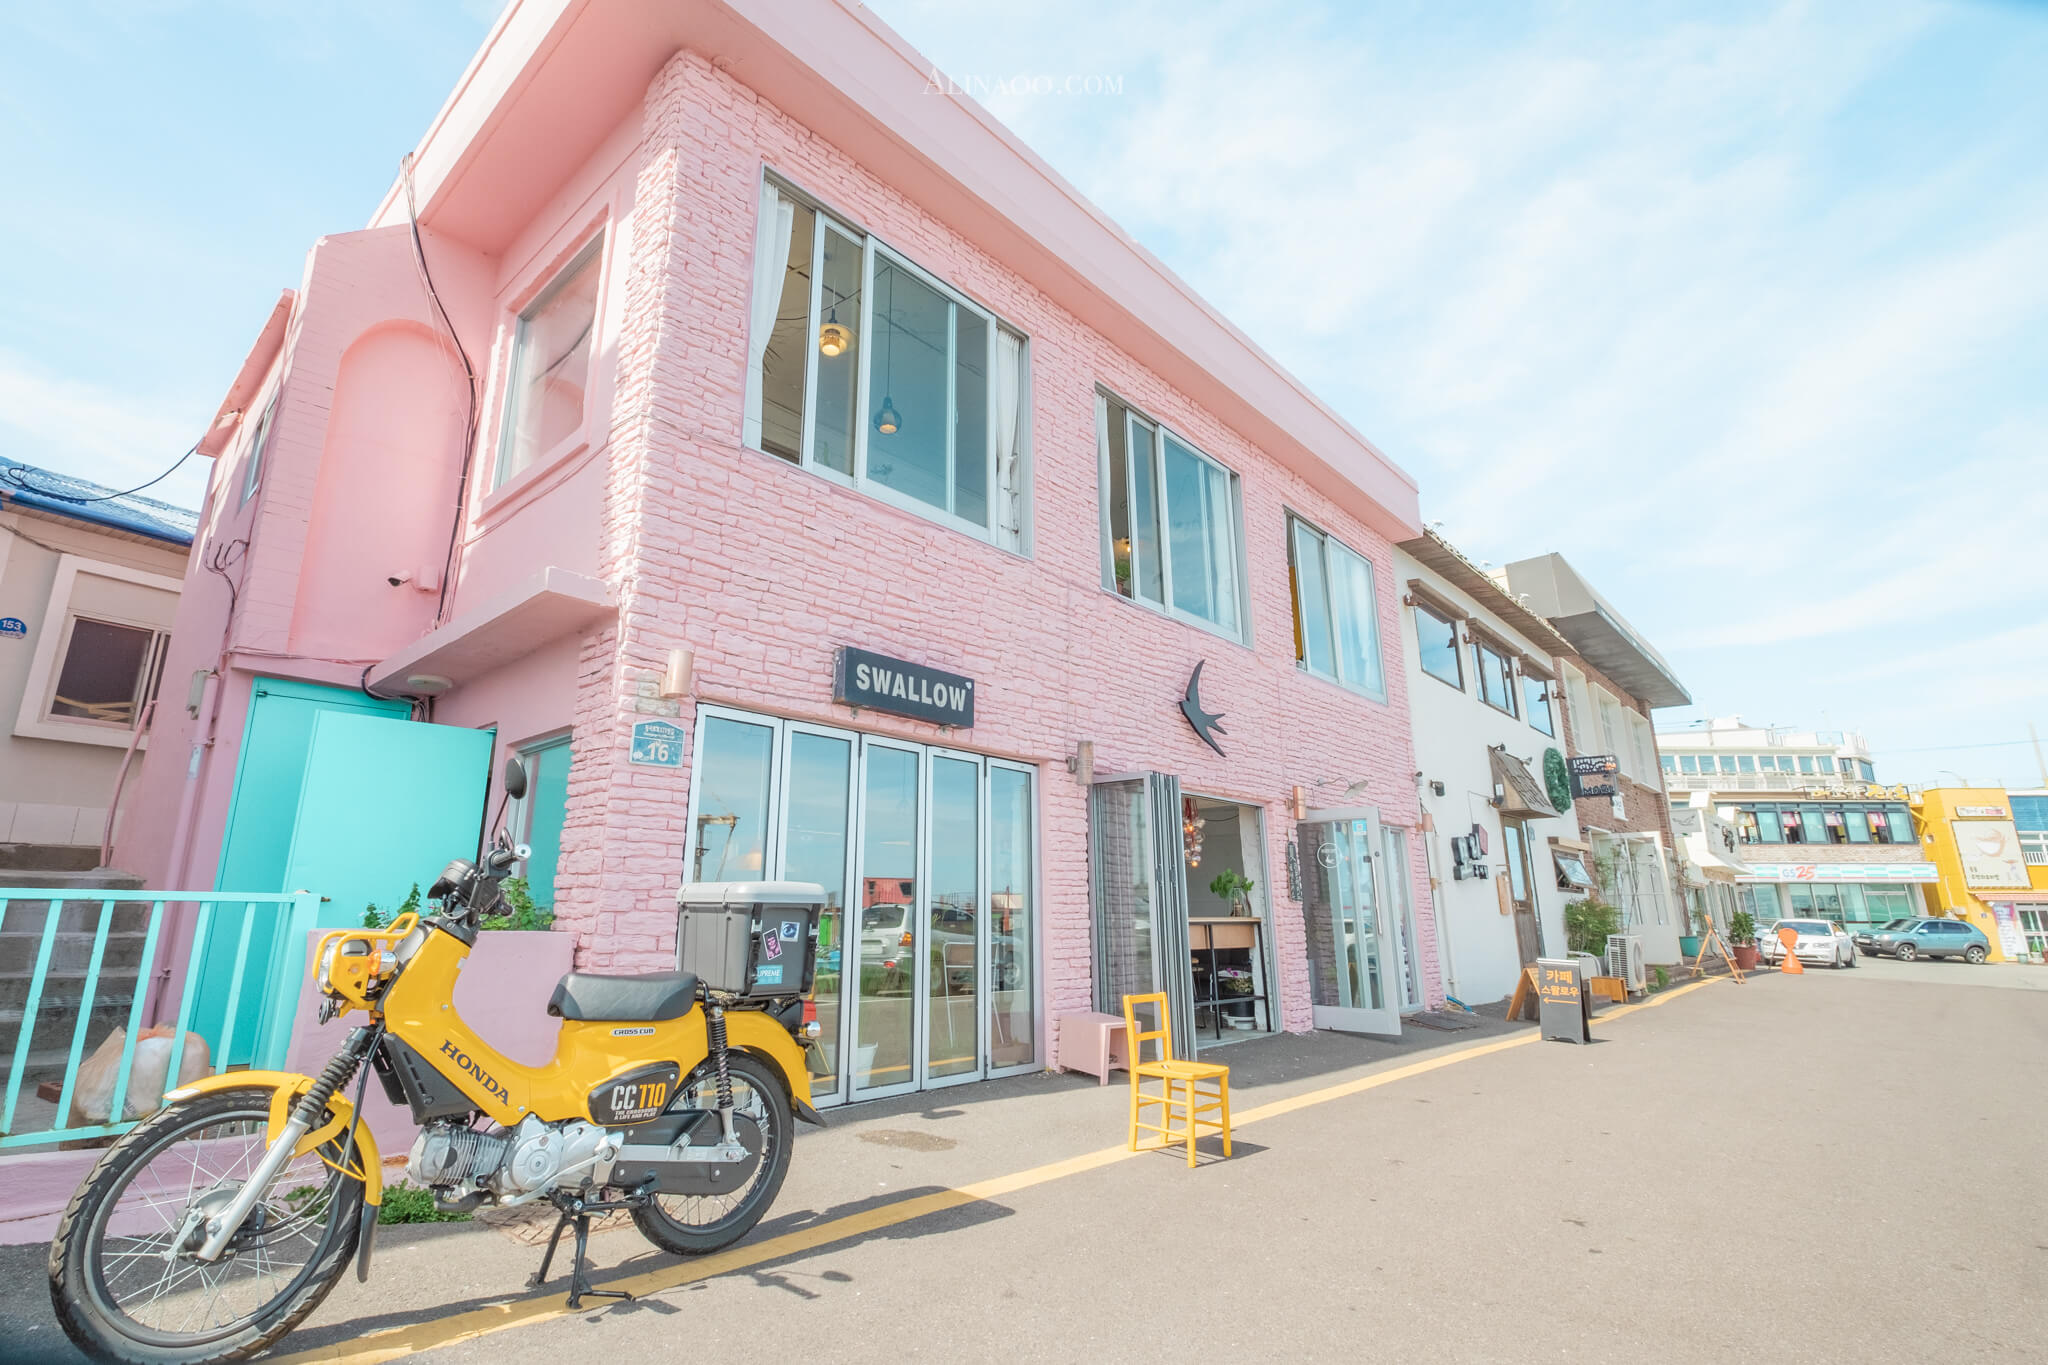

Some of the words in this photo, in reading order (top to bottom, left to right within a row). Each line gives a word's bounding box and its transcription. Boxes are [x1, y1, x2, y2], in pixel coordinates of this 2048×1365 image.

[3, 620, 21, 629] 153
[856, 663, 966, 712] SWALLOW
[648, 742, 669, 762] 16
[1782, 865, 1817, 880] GS25
[758, 968, 780, 977] UPREME
[1546, 969, 1573, 984] 카페
[1541, 985, 1579, 997] 스왈로우
[440, 1039, 509, 1106] HONDA
[610, 1085, 637, 1111] CC
[639, 1083, 667, 1109] 110
